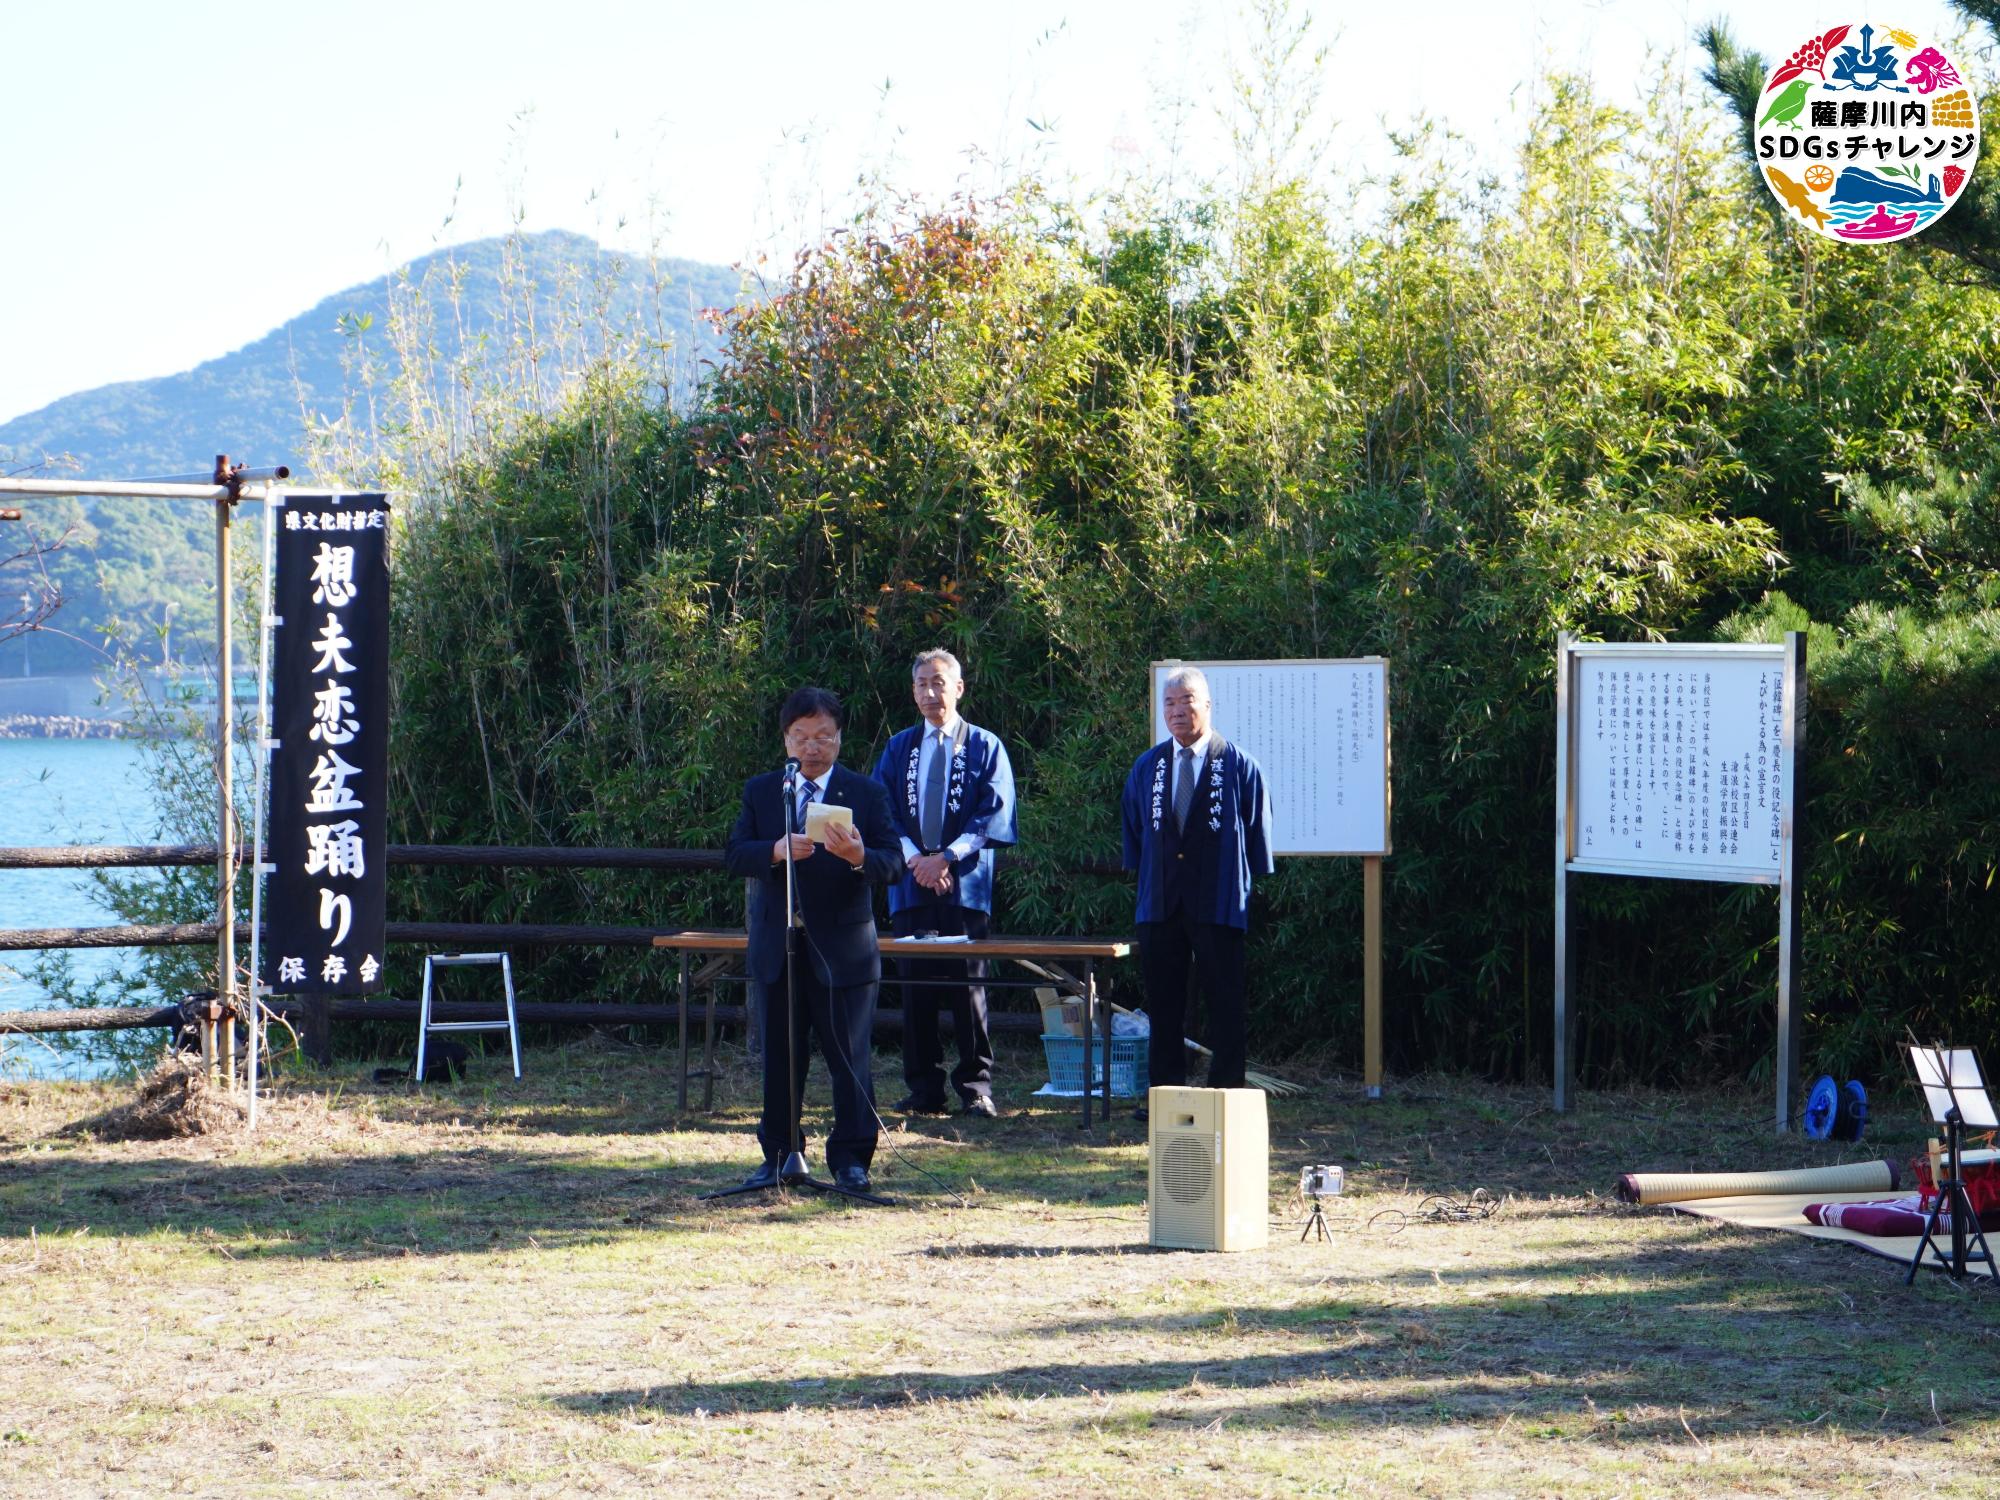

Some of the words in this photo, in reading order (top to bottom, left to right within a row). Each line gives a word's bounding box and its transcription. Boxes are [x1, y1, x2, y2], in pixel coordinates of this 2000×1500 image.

[285, 508, 385, 531] 県文化財指定
[304, 541, 366, 948] 想夫恋盆踊り
[1757, 671, 1768, 808] よびかえる為の宣言文
[948, 744, 966, 813] 薩摩川内市
[1209, 758, 1224, 831] 薩摩川内市
[1719, 760, 1729, 855] 生涯学習振興会
[1743, 752, 1751, 829] 平成八年四月吉日
[1585, 825, 1593, 846] 以上
[278, 954, 381, 984] 保存会
